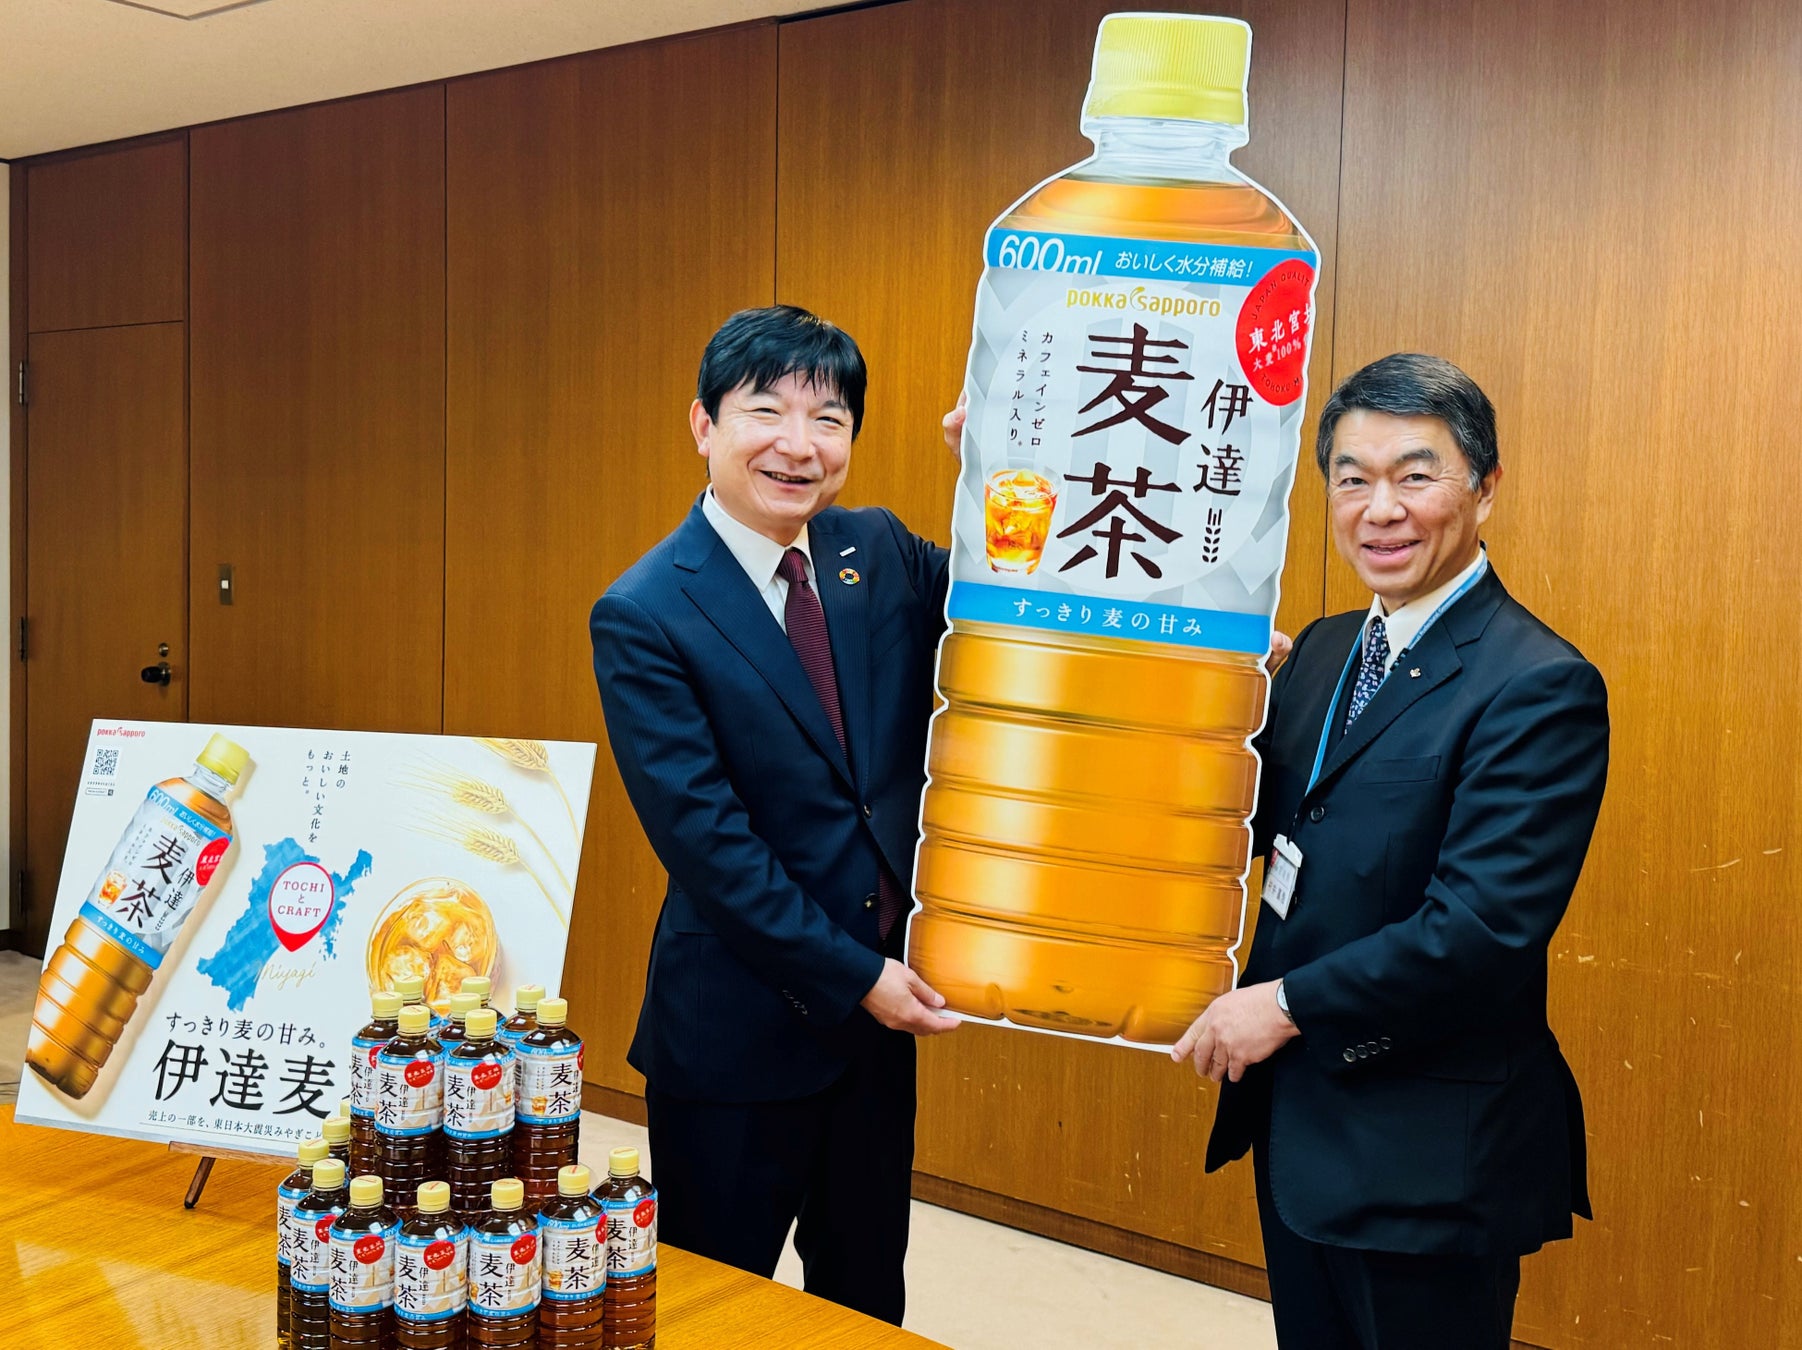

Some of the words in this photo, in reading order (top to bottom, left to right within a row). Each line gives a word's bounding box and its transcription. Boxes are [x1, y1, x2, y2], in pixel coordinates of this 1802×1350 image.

[998, 234, 1103, 275] 600ml
[1251, 281, 1277, 320] JAPAN
[1280, 271, 1310, 287] QUALIT
[1031, 331, 1053, 446] カフェインゼロ
[1260, 373, 1291, 393] TOHOKU
[1056, 322, 1196, 580] 麦茶
[1192, 378, 1254, 497] 伊達
[1013, 597, 1202, 637] すっきり麦の甘み
[302, 749, 315, 795] もっと。
[336, 750, 351, 789] 土地の
[308, 751, 334, 843] おいしい文化を
[115, 834, 186, 929] 麦茶
[164, 867, 195, 911] 伊達
[283, 881, 325, 893] TOCHI
[277, 905, 321, 918] CRAFT
[253, 960, 316, 991] Miyagi
[166, 1011, 326, 1049] すっきり麦の甘み。
[152, 1038, 350, 1120] 伊達麦
[379, 1072, 398, 1124] 麦茶
[447, 1074, 465, 1127] 麦茶
[548, 1063, 573, 1114] 麦茶
[292, 1227, 309, 1280] 麦茶
[564, 1237, 591, 1290] 麦茶
[606, 1218, 627, 1269] 麦茶
[331, 1247, 347, 1302] 麦茶
[398, 1254, 418, 1309] 麦茶
[479, 1252, 503, 1306] 麦茶
